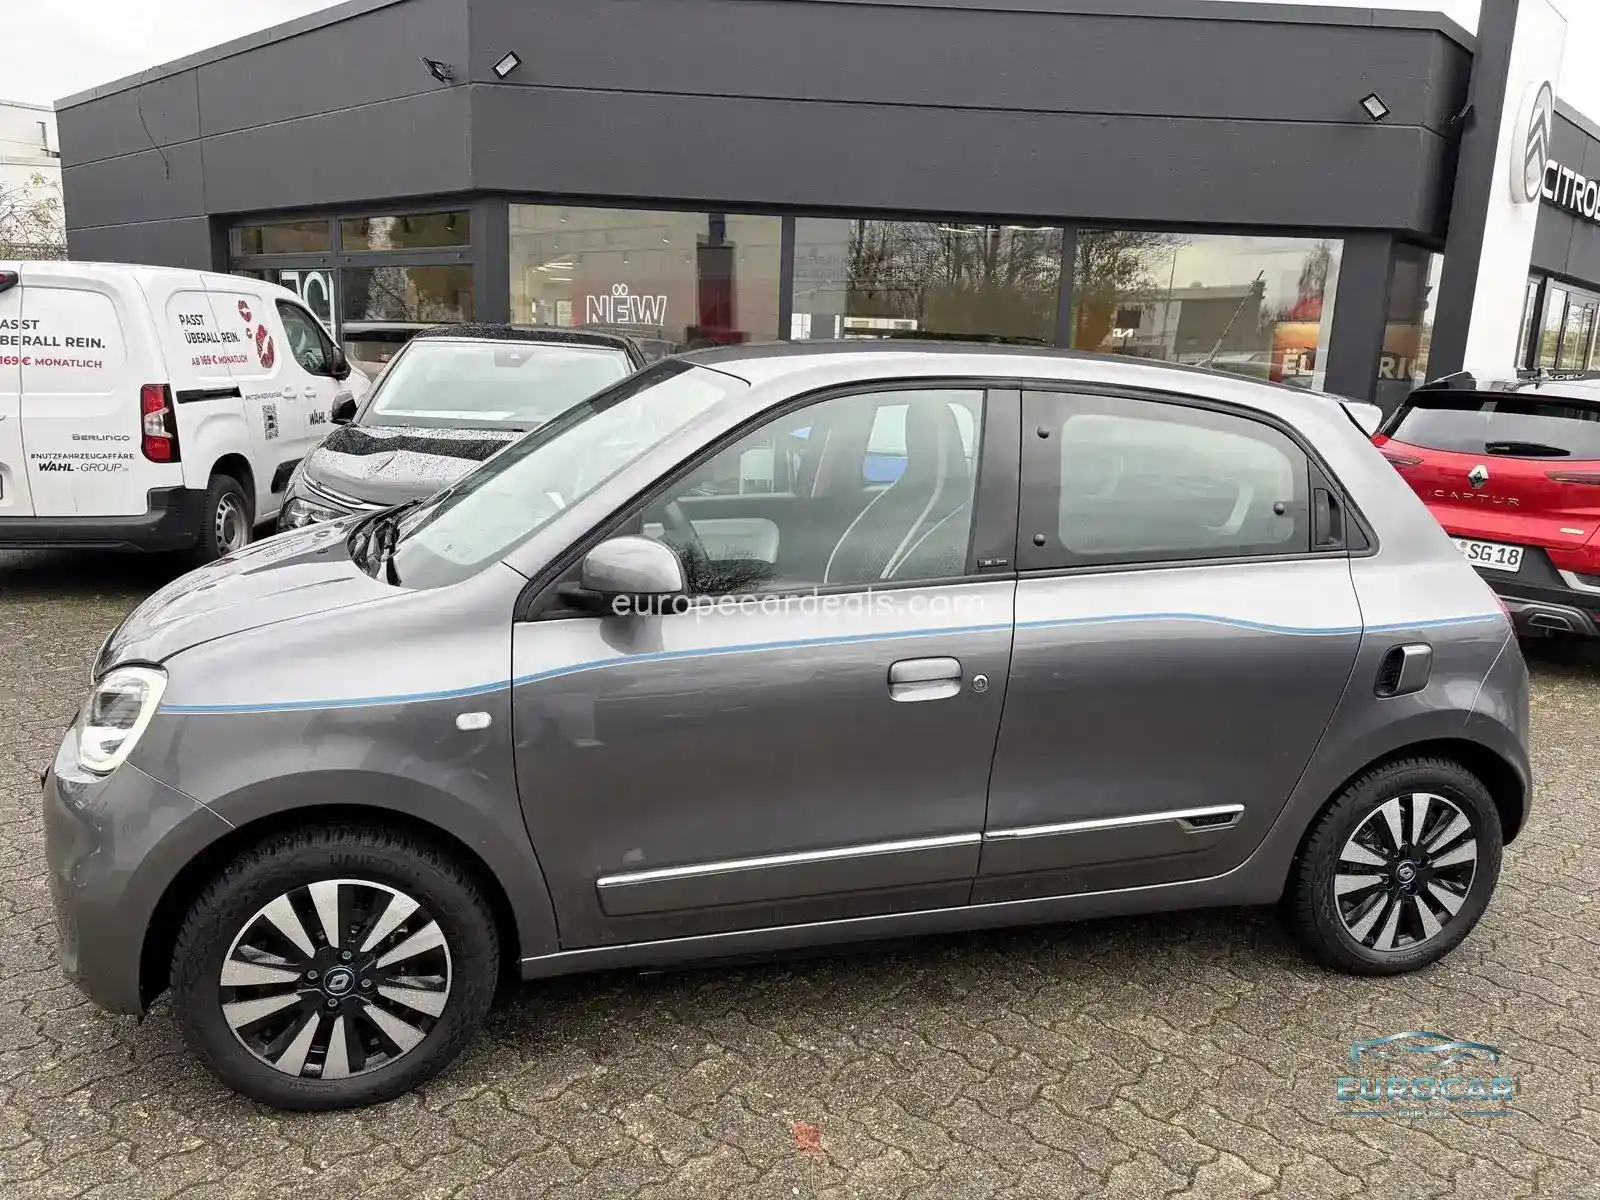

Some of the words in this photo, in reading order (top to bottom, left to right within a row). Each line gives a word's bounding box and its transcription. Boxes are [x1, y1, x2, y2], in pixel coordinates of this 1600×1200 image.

[179, 314, 204, 326] PASST
[65, 336, 106, 349] REIN.
[184, 329, 220, 344] ÜBERALL
[221, 331, 241, 343] REIN.
[21, 356, 32, 366] €
[34, 358, 102, 369] MONATLICH
[218, 354, 249, 365] MONATLICH
[72, 433, 130, 442] BERLINGO
[1433, 488, 1521, 506] CAPTUR
[1467, 543, 1493, 562] SG
[1495, 547, 1520, 565] 18
